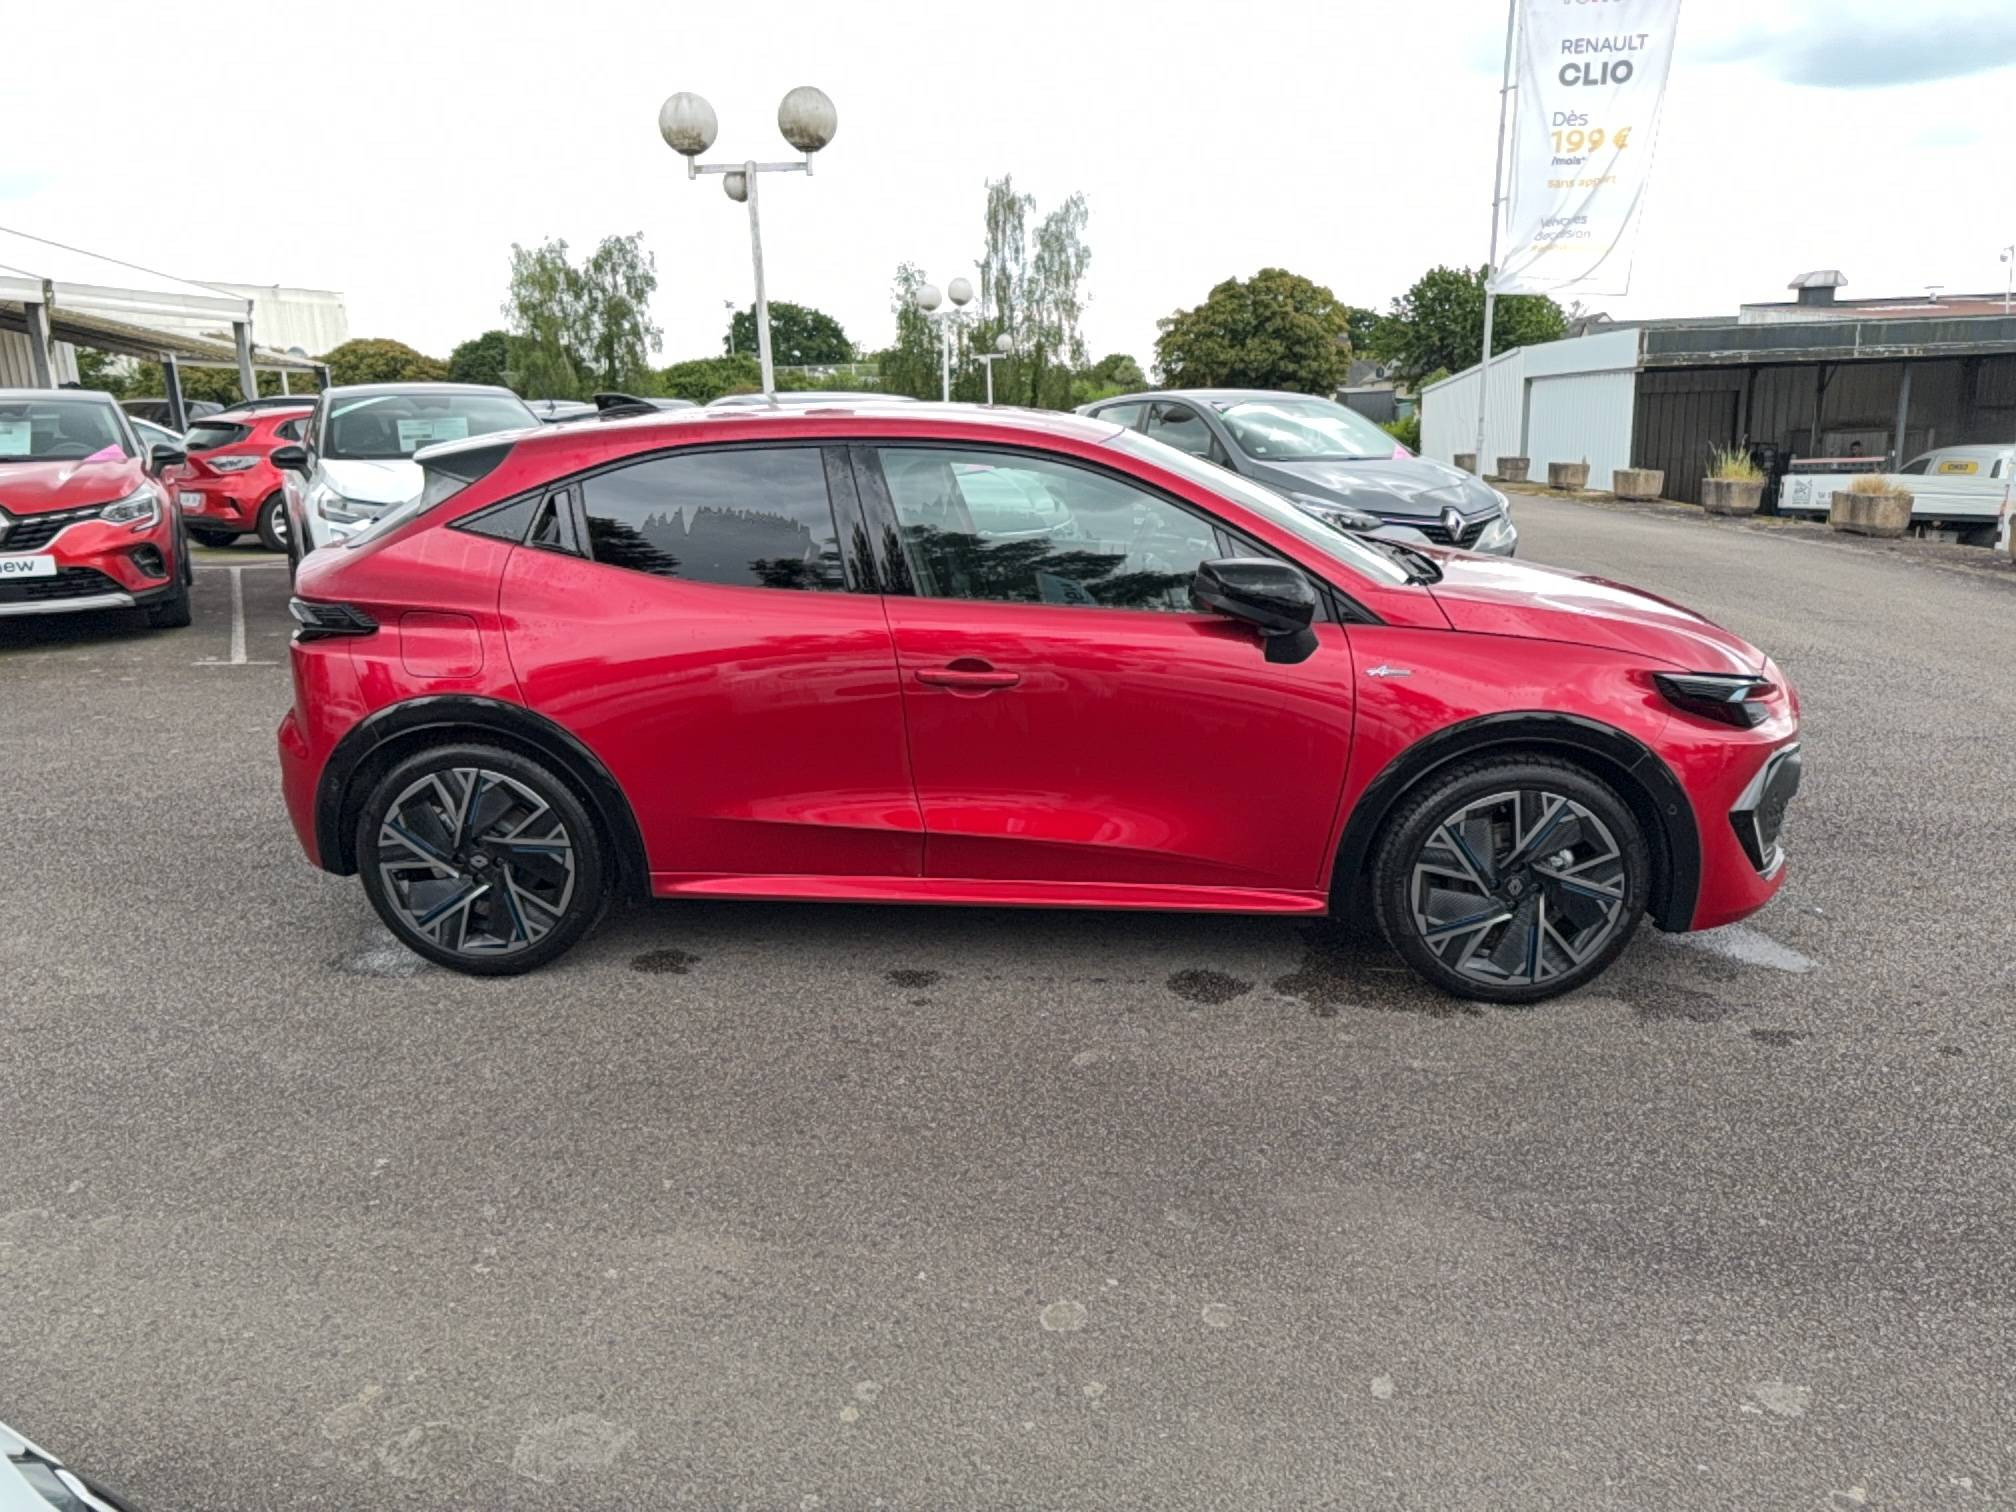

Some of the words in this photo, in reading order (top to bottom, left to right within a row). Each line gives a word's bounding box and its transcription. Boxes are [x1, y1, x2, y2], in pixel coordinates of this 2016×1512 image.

[1561, 33, 1649, 54] RENAULT
[1558, 59, 1633, 86] CLIO
[1552, 109, 1589, 127] Dès
[1551, 127, 1605, 153] 199
[1612, 126, 1632, 149] €
